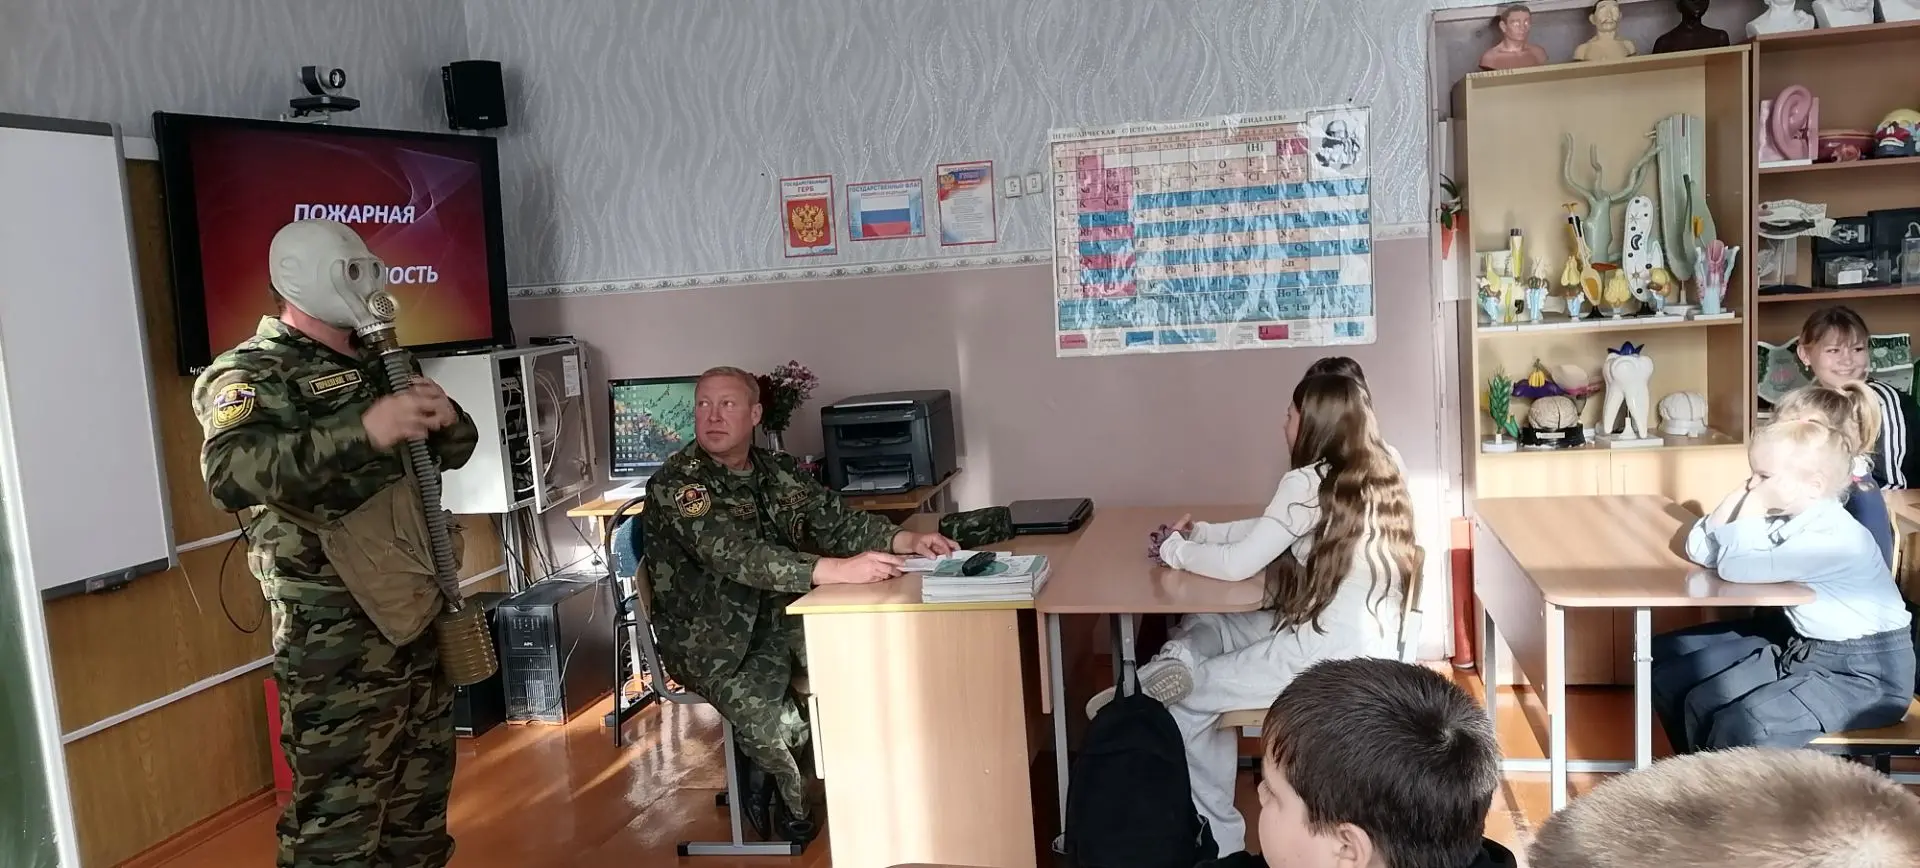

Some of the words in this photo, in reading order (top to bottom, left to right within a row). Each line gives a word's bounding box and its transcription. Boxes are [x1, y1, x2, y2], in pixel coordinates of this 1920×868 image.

[1218, 160, 1227, 169] O
[294, 204, 416, 224] ПОЖАРНАЯ
[385, 266, 438, 284] ОСТЬ
